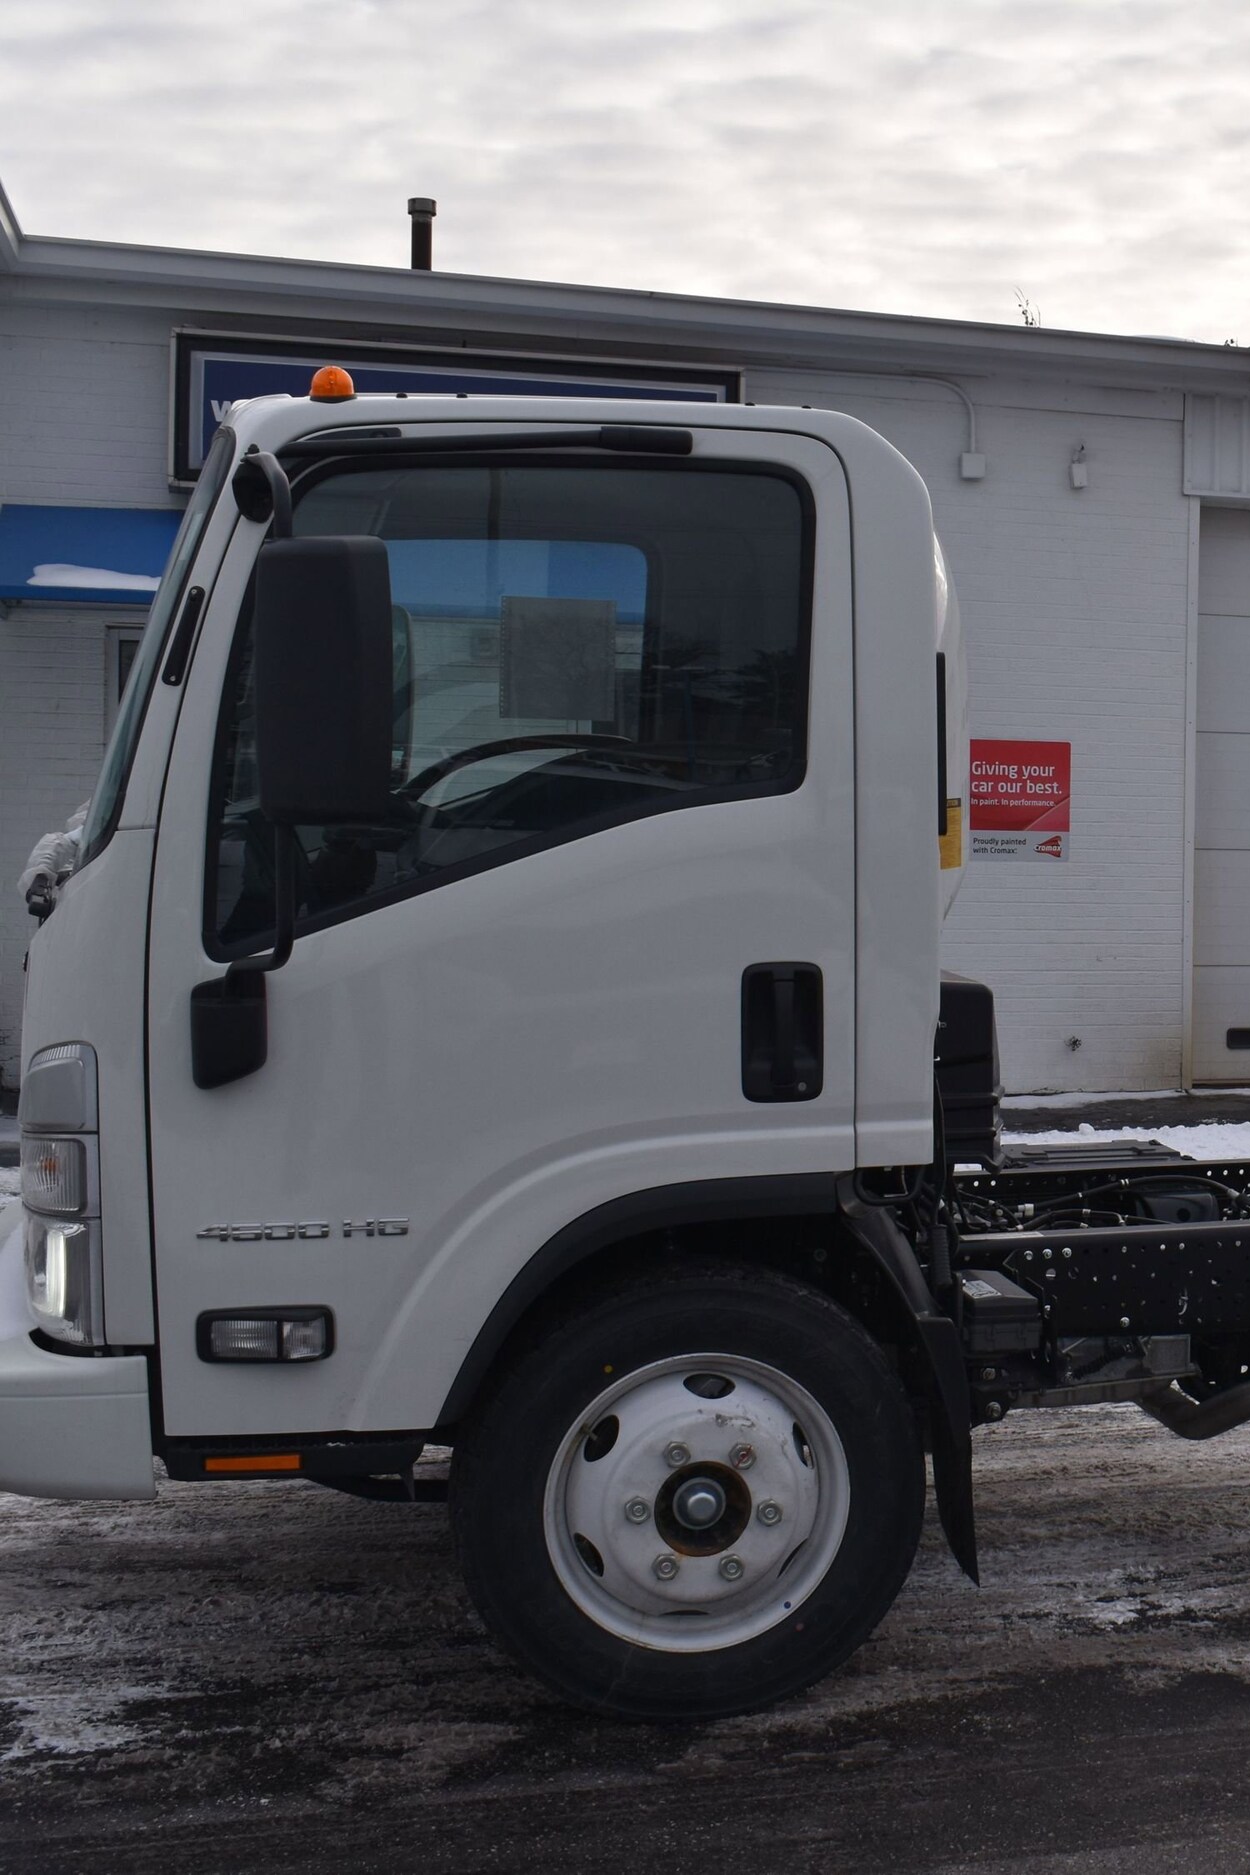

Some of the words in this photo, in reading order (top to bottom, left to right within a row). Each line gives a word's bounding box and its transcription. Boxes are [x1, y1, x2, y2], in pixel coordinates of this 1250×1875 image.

[971, 761, 1018, 779] Giving
[1022, 765, 1055, 779] your
[971, 781, 994, 793] car
[998, 782, 1022, 793] our
[1026, 780, 1062, 795] best.
[970, 797, 978, 805] In
[979, 798, 1000, 807] paint.
[1009, 799, 1055, 808] performance.
[973, 837, 999, 846] Proudly
[1000, 838, 1027, 846] painted
[1034, 844, 1061, 853] Cromax
[196, 1220, 329, 1242] 4500
